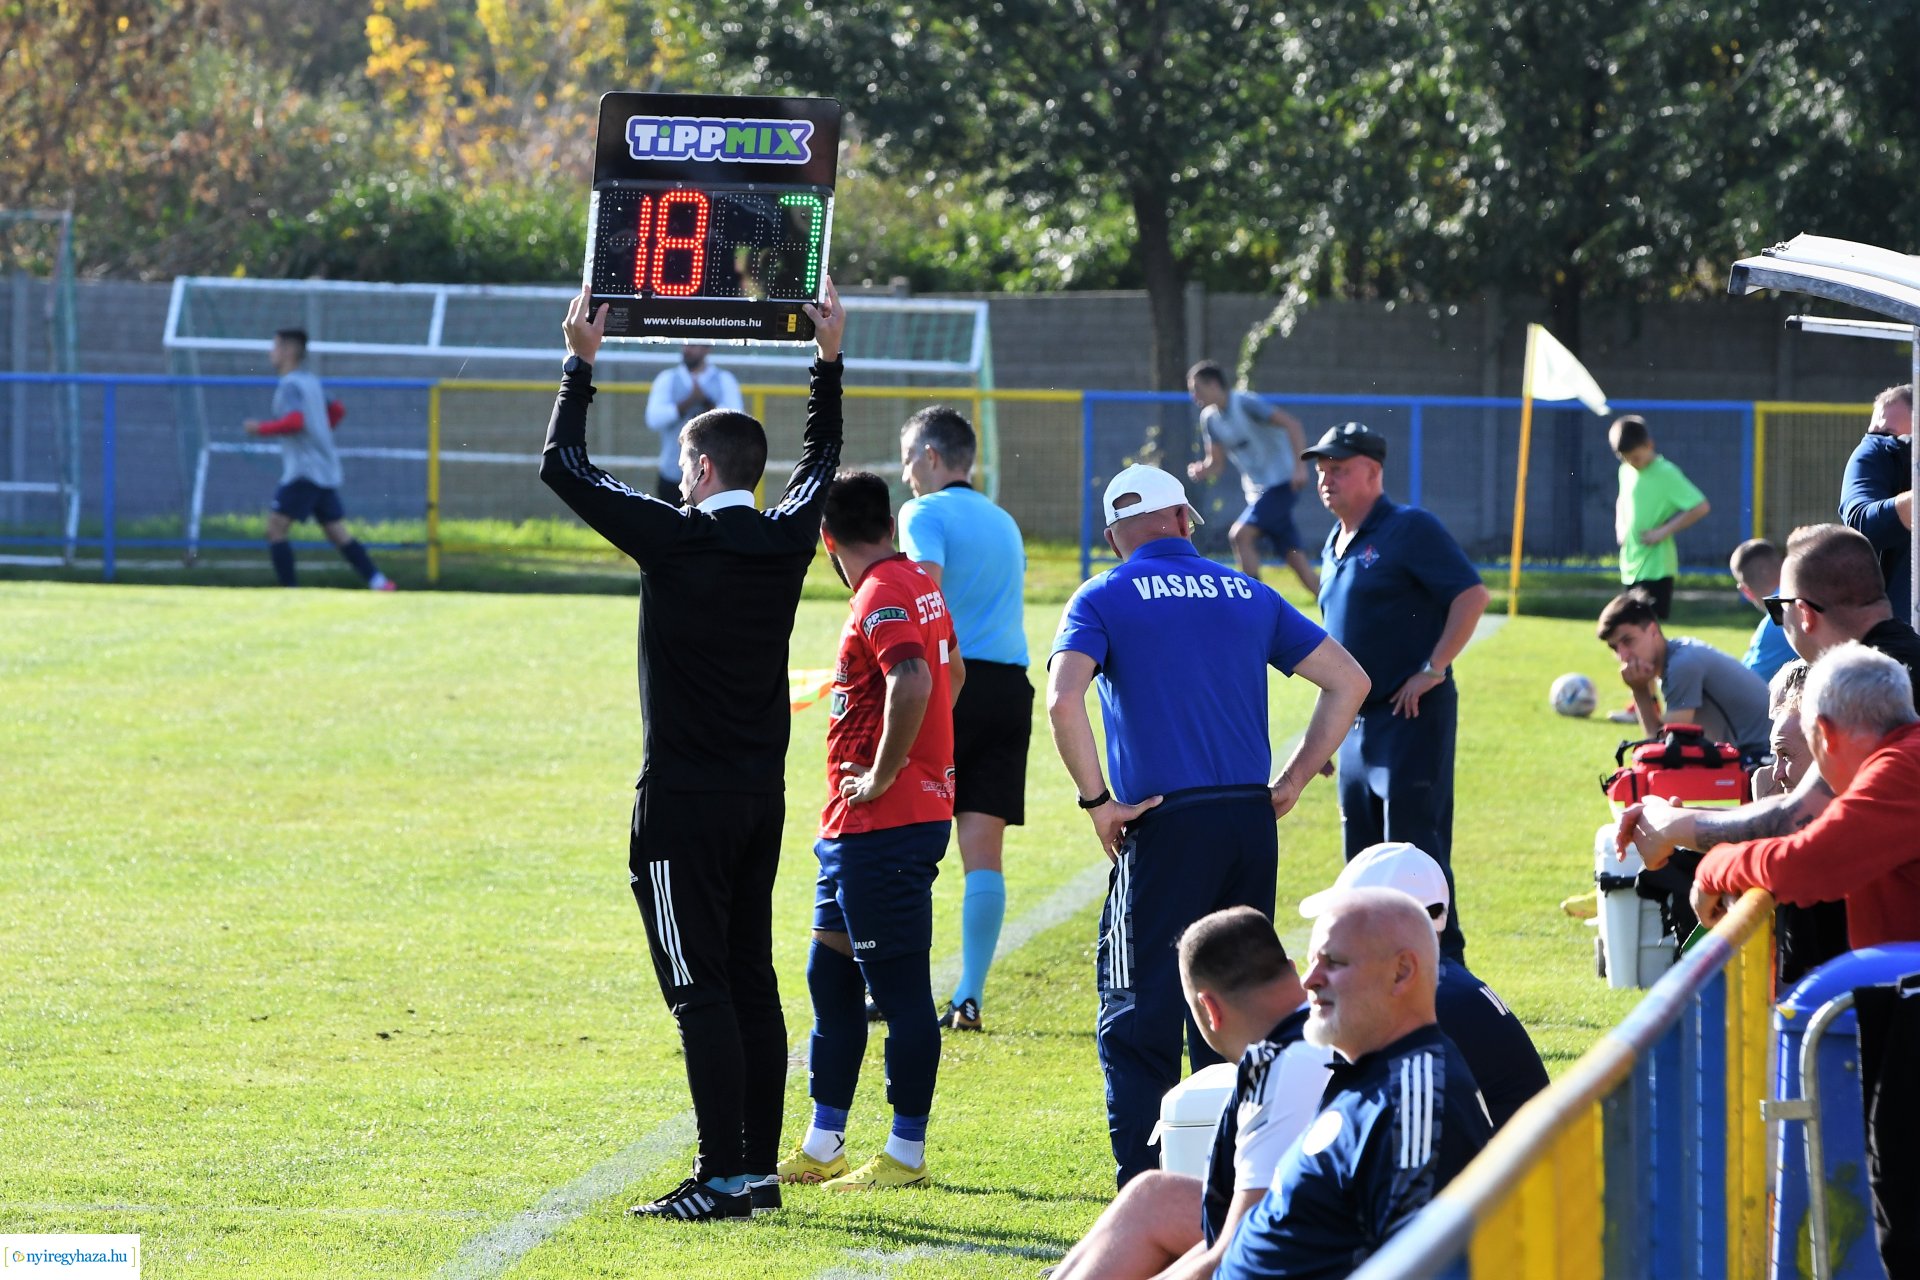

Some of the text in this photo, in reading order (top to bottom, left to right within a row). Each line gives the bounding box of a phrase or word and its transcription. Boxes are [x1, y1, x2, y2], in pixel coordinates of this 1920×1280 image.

[634, 191, 822, 295] 18 7
[643, 316, 762, 328] www.visualsolutions.hu
[1132, 574, 1253, 600] VASAS FC
